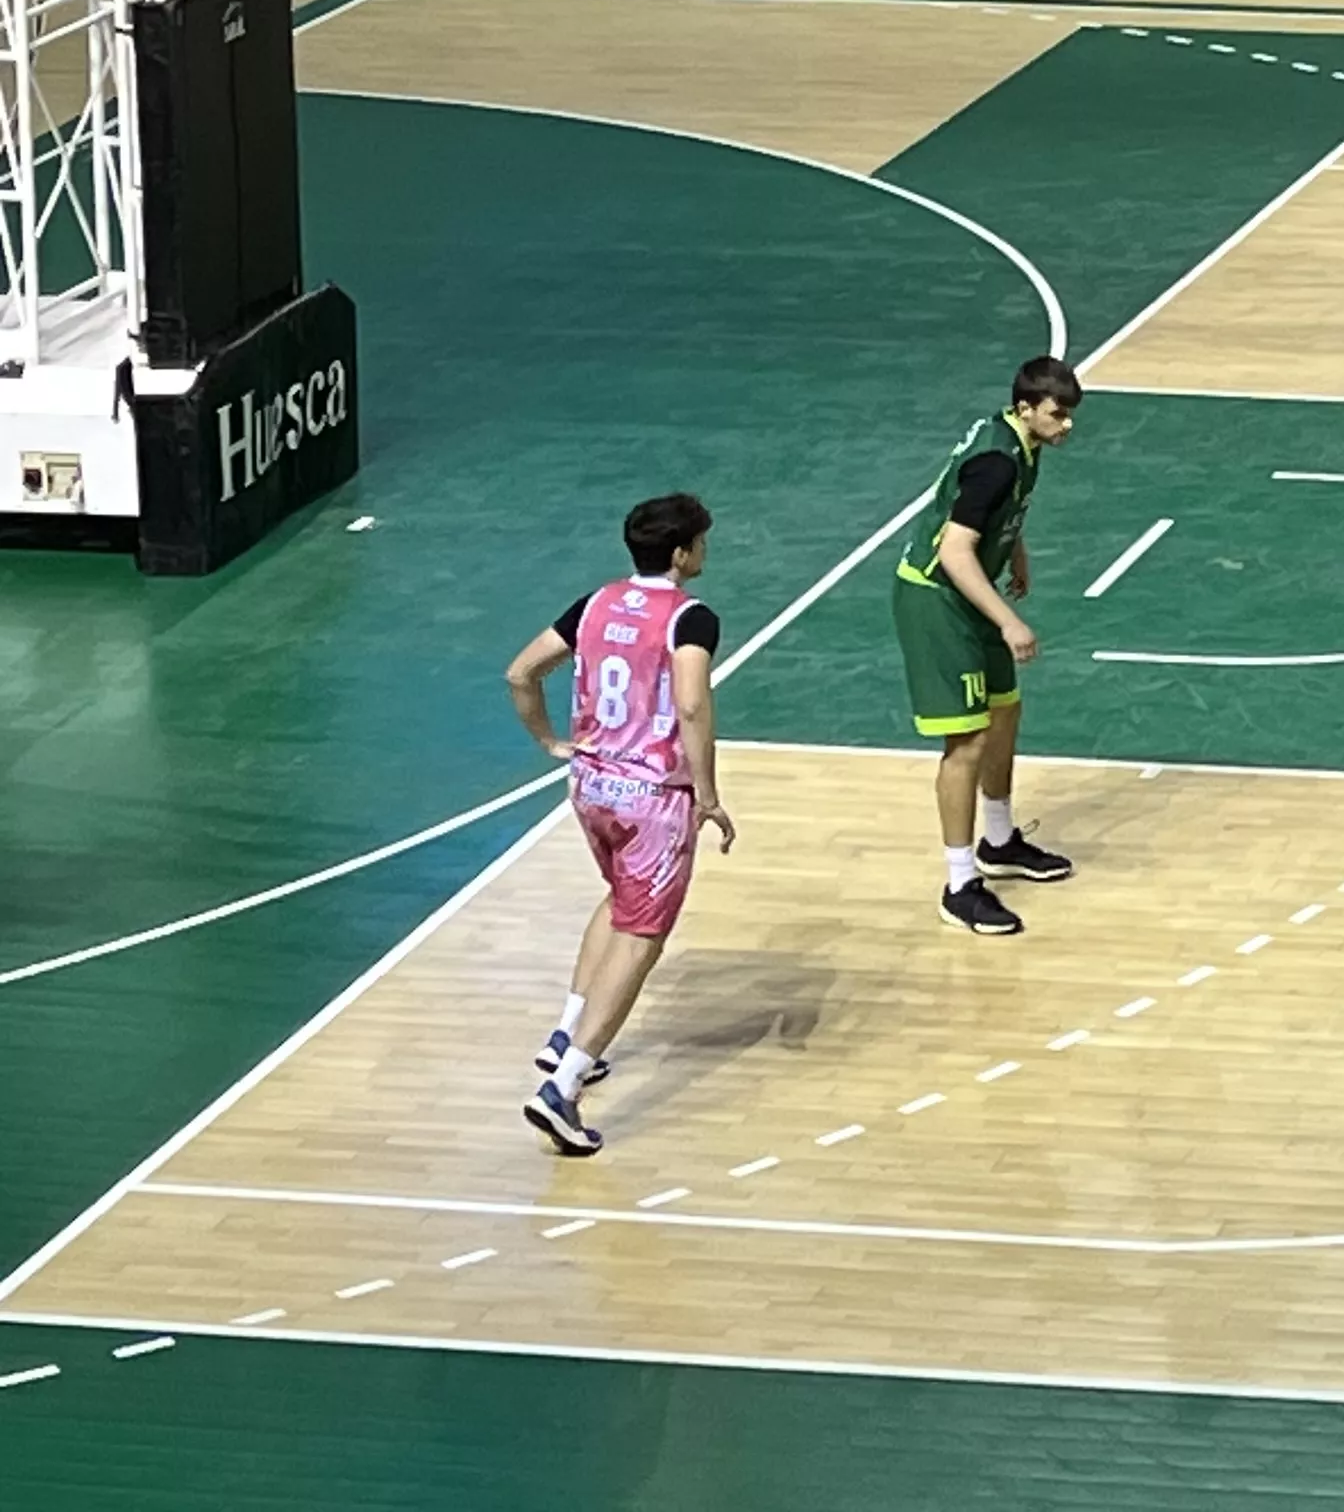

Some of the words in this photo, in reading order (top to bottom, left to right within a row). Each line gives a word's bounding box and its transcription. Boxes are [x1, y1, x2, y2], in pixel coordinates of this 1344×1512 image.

[216, 359, 348, 503] Huesca
[595, 654, 632, 730] 8
[960, 670, 986, 708] 14
